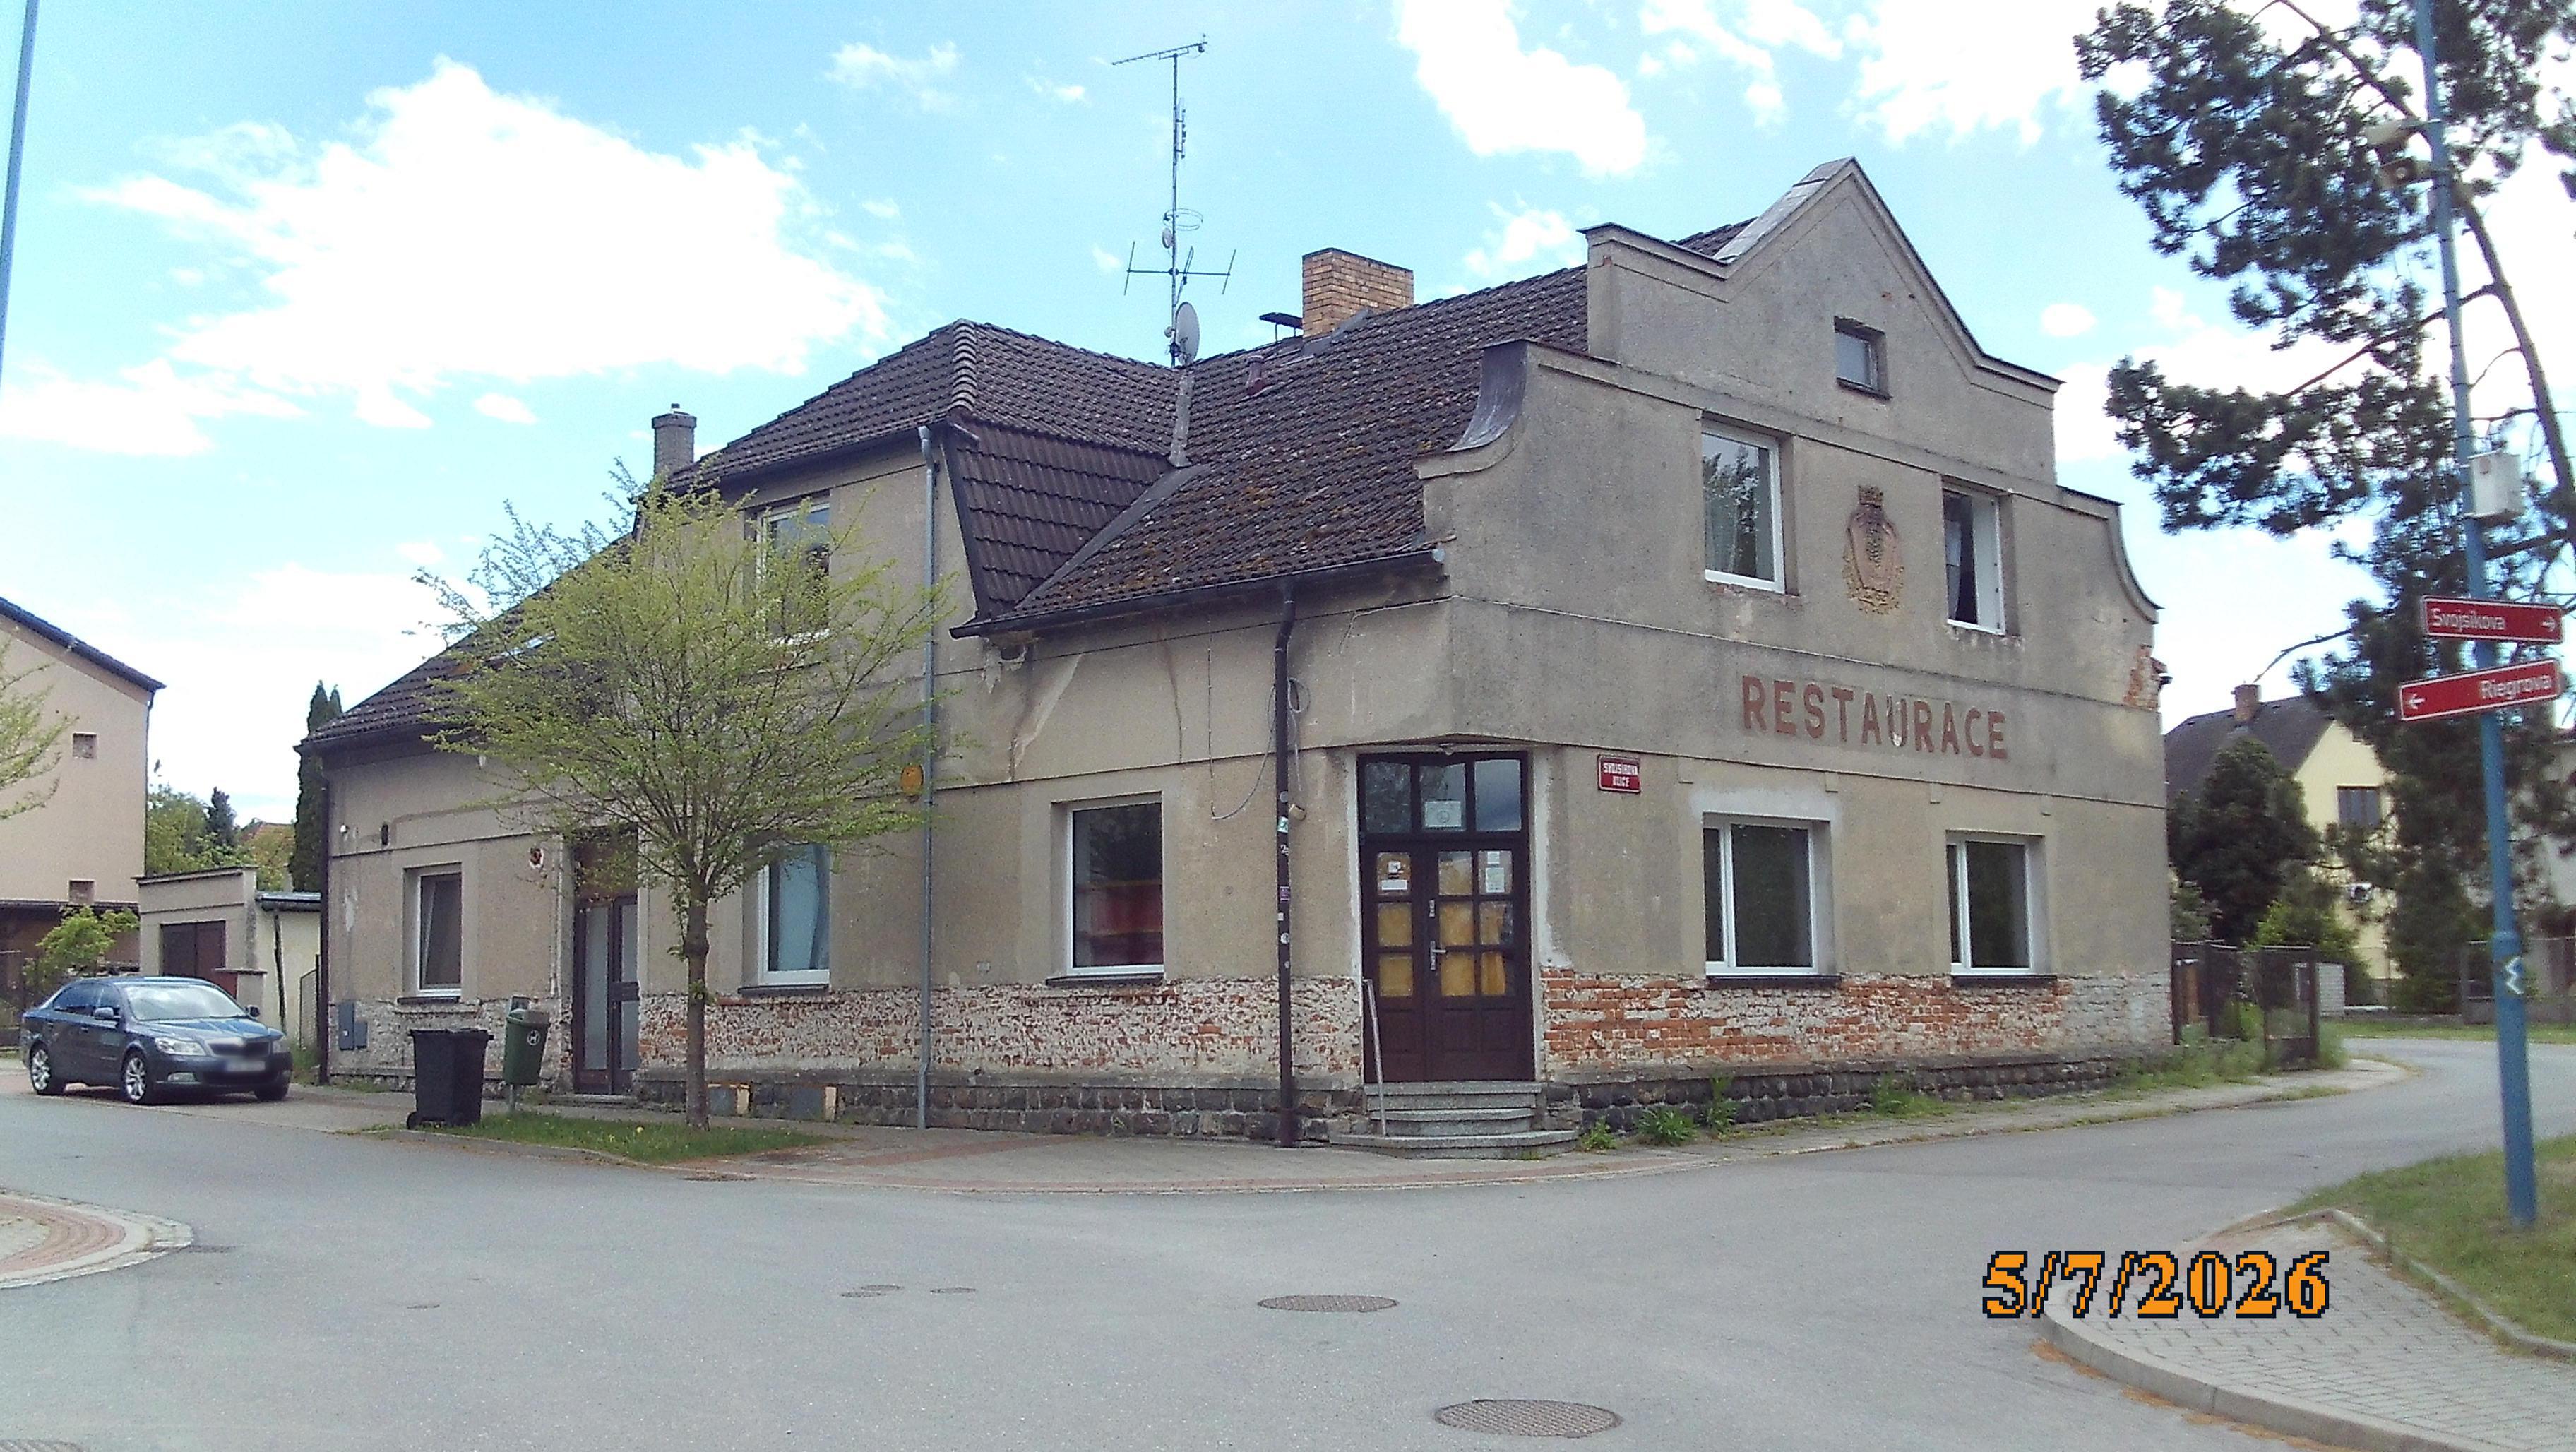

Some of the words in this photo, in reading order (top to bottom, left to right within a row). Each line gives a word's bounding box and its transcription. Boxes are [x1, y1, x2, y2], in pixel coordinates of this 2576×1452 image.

[2480, 675, 2551, 700] Riegrova
[1741, 674, 2008, 760] RESTAURACE
[1613, 775, 1630, 787] ULICE
